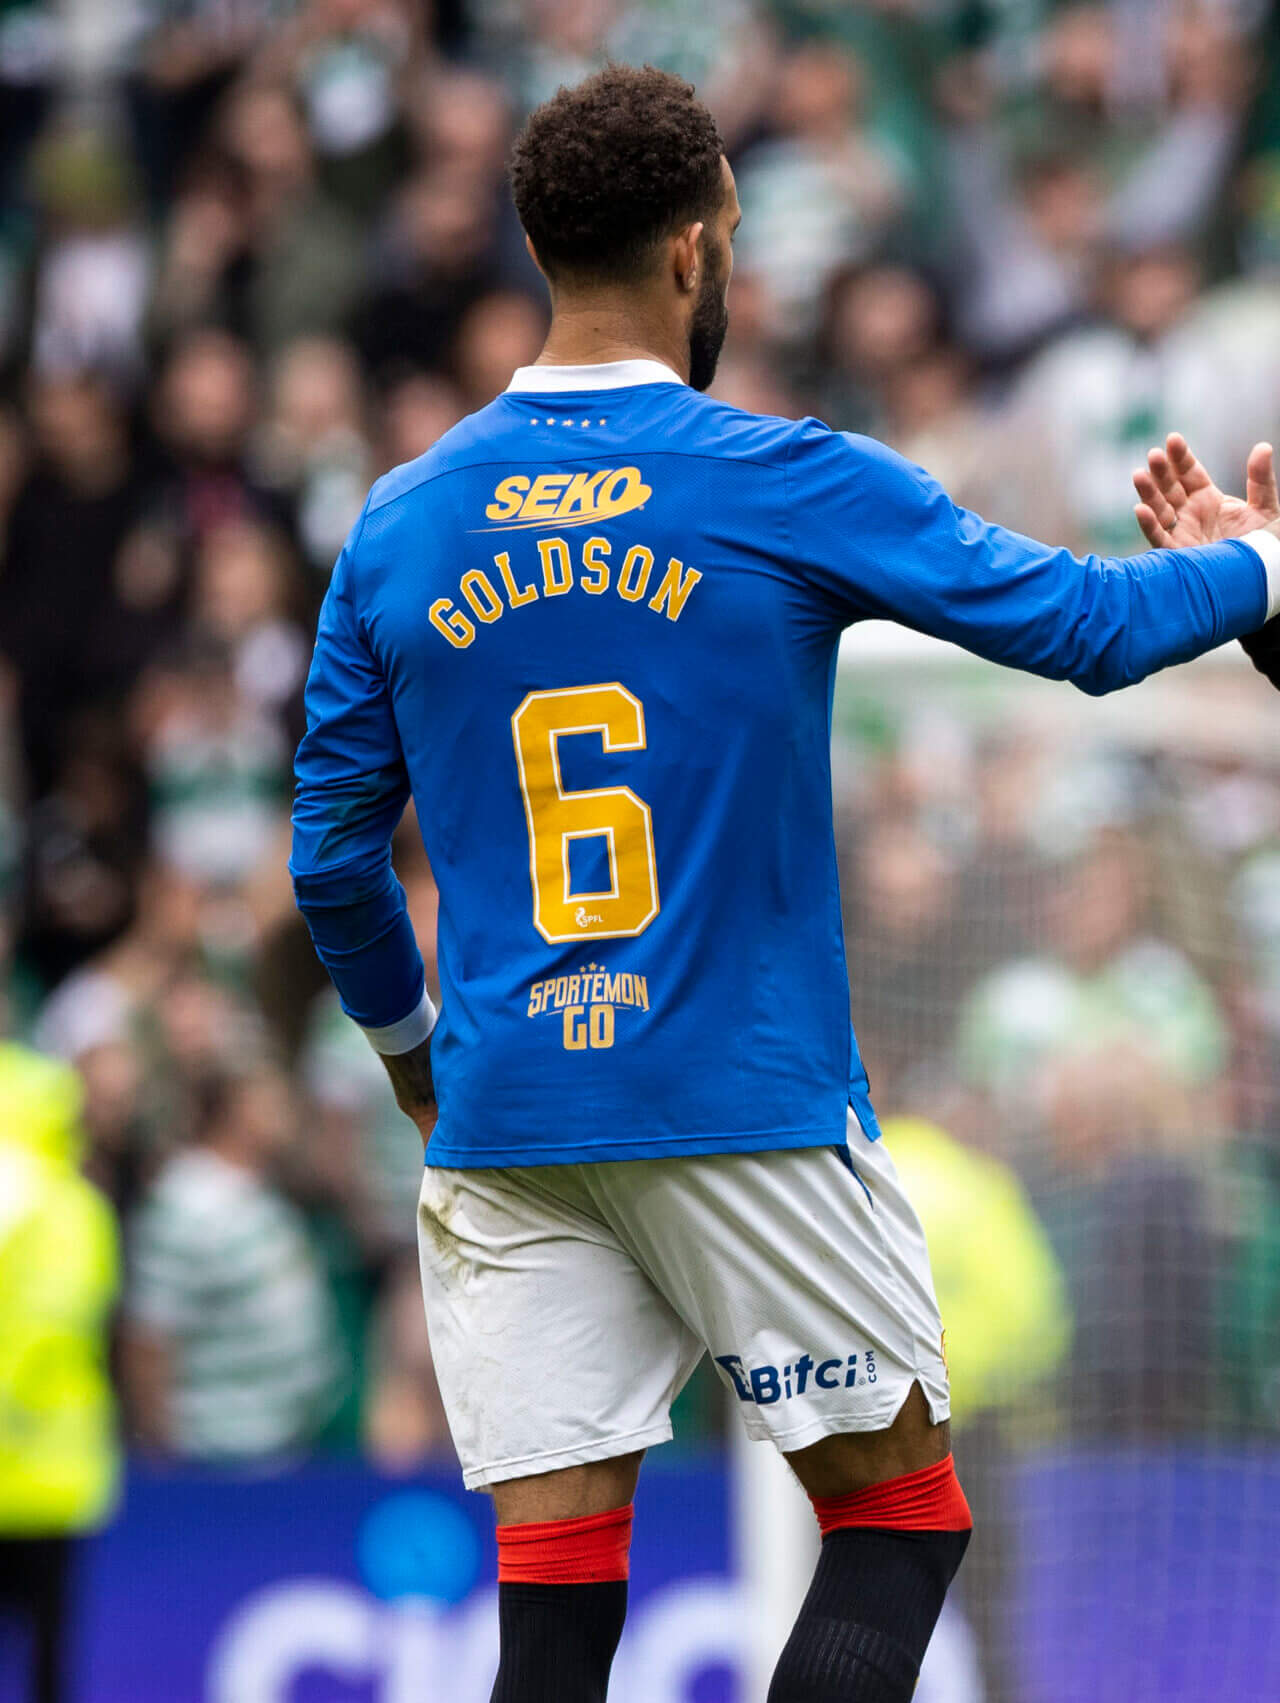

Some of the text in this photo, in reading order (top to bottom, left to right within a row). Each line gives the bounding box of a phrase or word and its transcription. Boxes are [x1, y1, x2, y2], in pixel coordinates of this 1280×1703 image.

[485, 466, 653, 521] SEKO
[428, 536, 702, 649] GOLDSON
[511, 681, 660, 944] 6
[527, 972, 650, 1018] SPORTEMON
[562, 1003, 615, 1051] GO
[750, 1353, 857, 1405] Bitci
